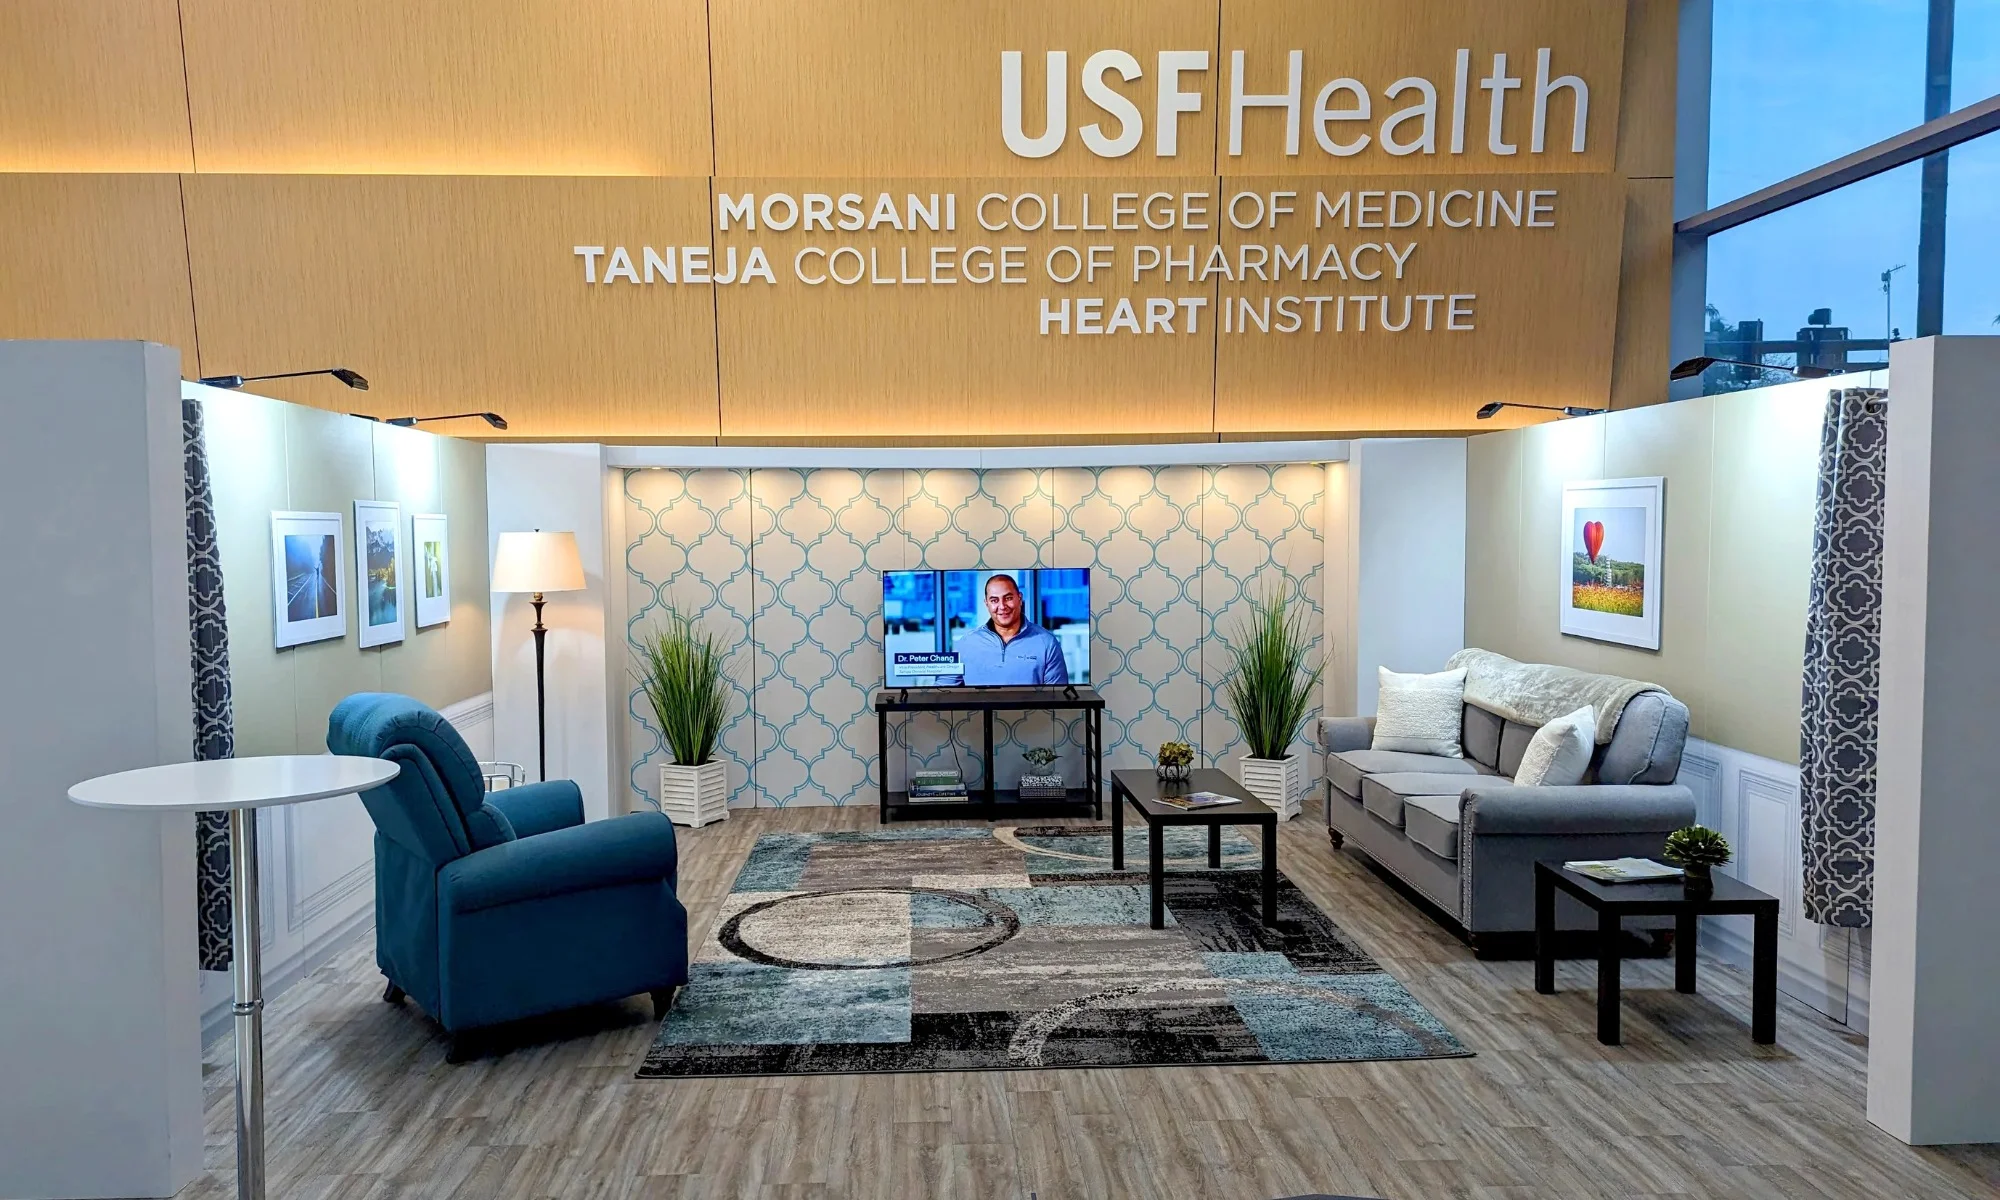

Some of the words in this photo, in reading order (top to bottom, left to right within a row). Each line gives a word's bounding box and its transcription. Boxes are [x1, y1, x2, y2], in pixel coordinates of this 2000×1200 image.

[718, 192, 957, 231] MORSANI
[976, 191, 1209, 232] COLLEGE
[1228, 191, 1297, 230] OF
[1315, 189, 1558, 228] MEDICINE
[573, 245, 777, 285] TANEJA
[794, 245, 1027, 286] COLLEGE
[1045, 245, 1114, 284] OF
[1133, 242, 1418, 283] PHARMACY
[1039, 297, 1208, 335] HEART
[1225, 293, 1476, 334] INSTITUTE
[930, 654, 954, 663] Chang
